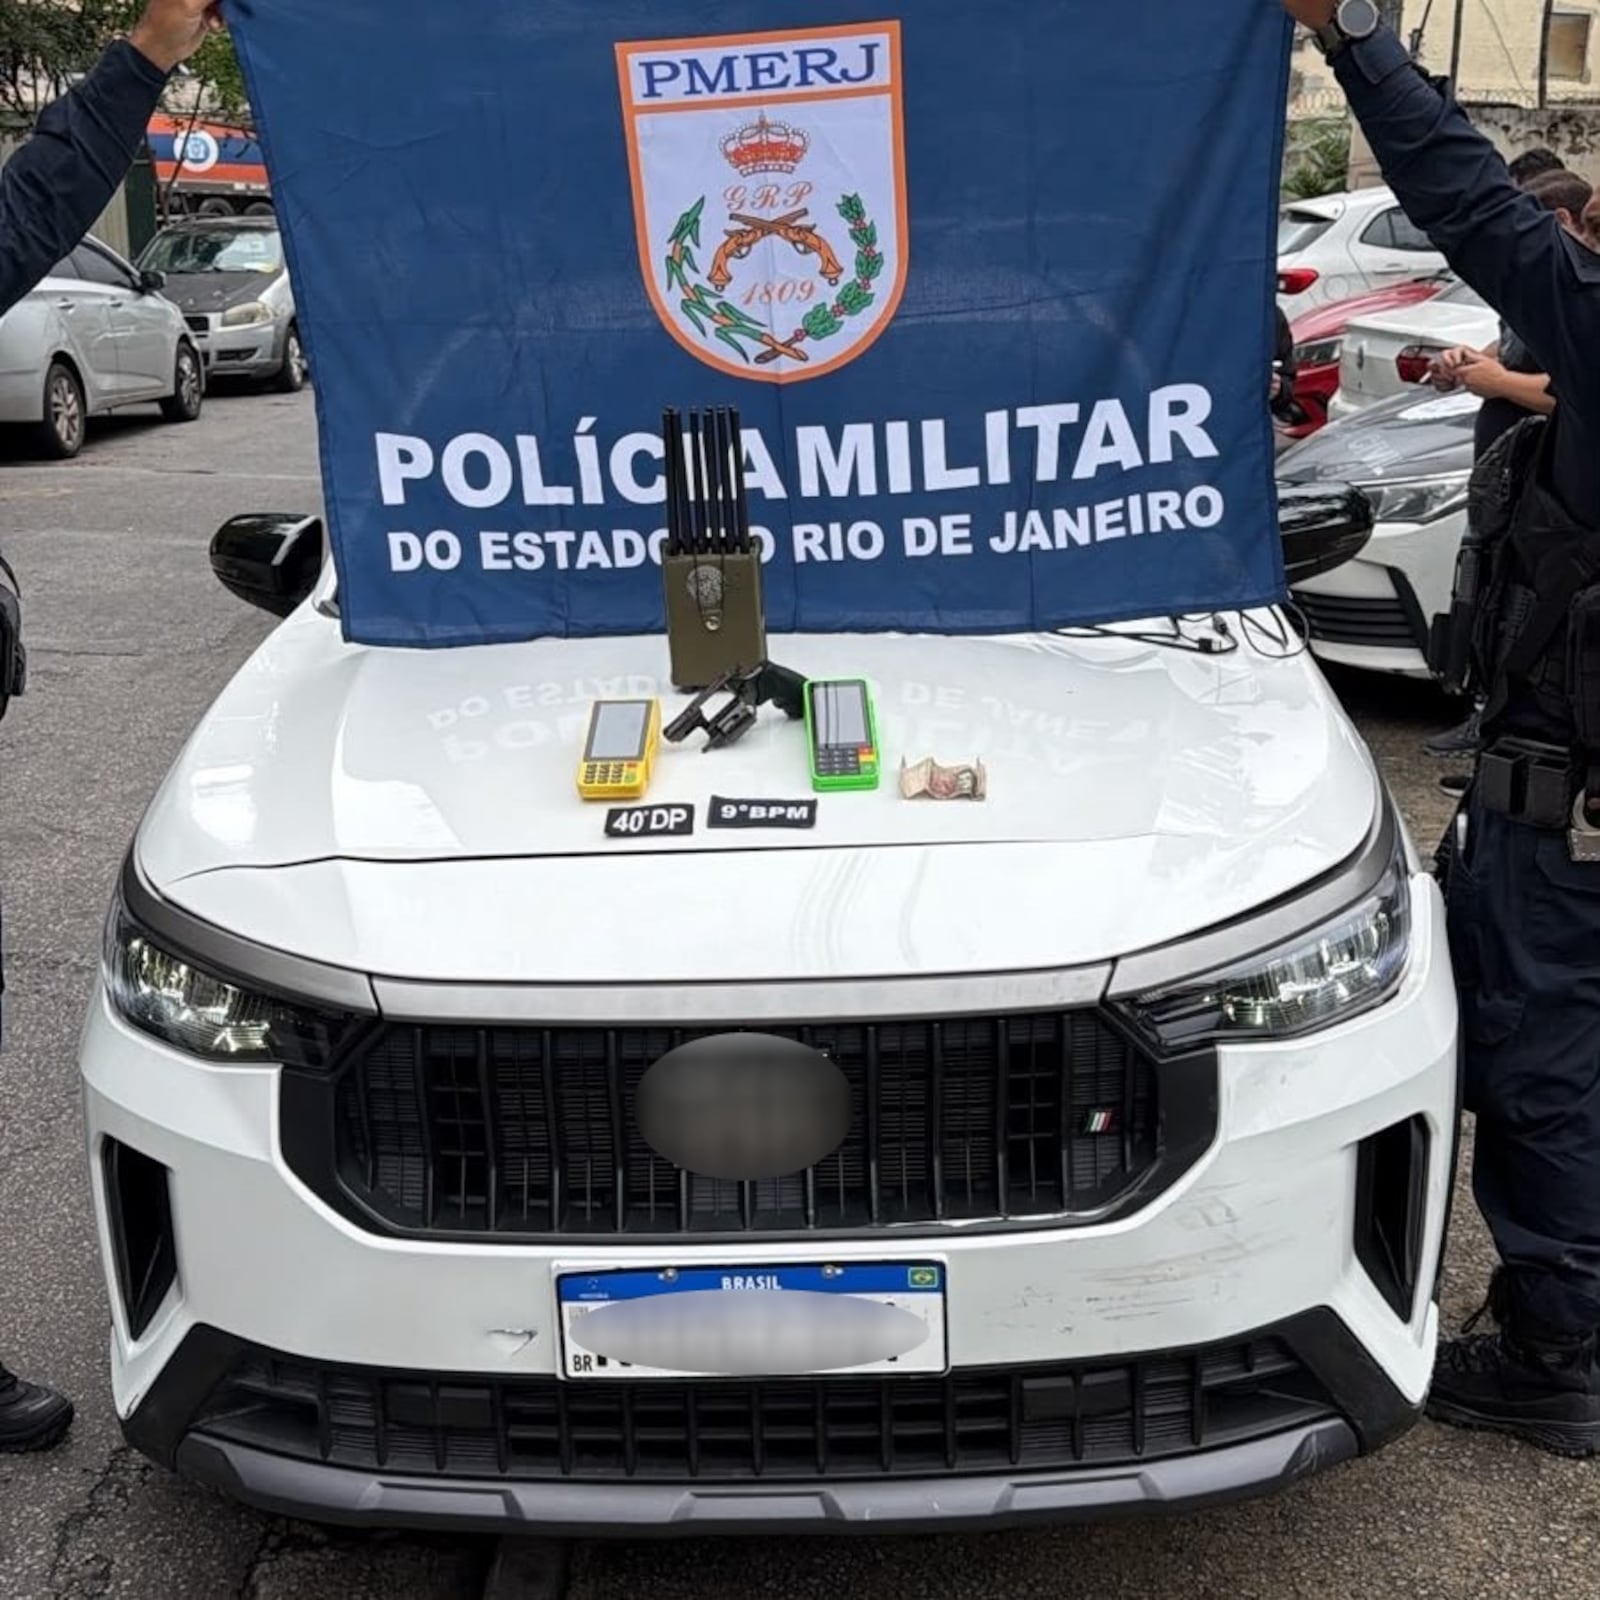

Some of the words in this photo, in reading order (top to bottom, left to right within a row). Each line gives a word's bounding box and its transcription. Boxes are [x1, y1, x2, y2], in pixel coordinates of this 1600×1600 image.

[638, 43, 880, 98] PMERJ
[740, 281, 815, 305] 1809
[796, 383, 1219, 497] MILITAR
[387, 530, 462, 572] DO
[792, 520, 884, 563] RIO
[903, 514, 973, 556] DE
[989, 485, 1224, 554] JANEIRO
[722, 1276, 782, 1290] BRASIL
[572, 1354, 593, 1372] BR
